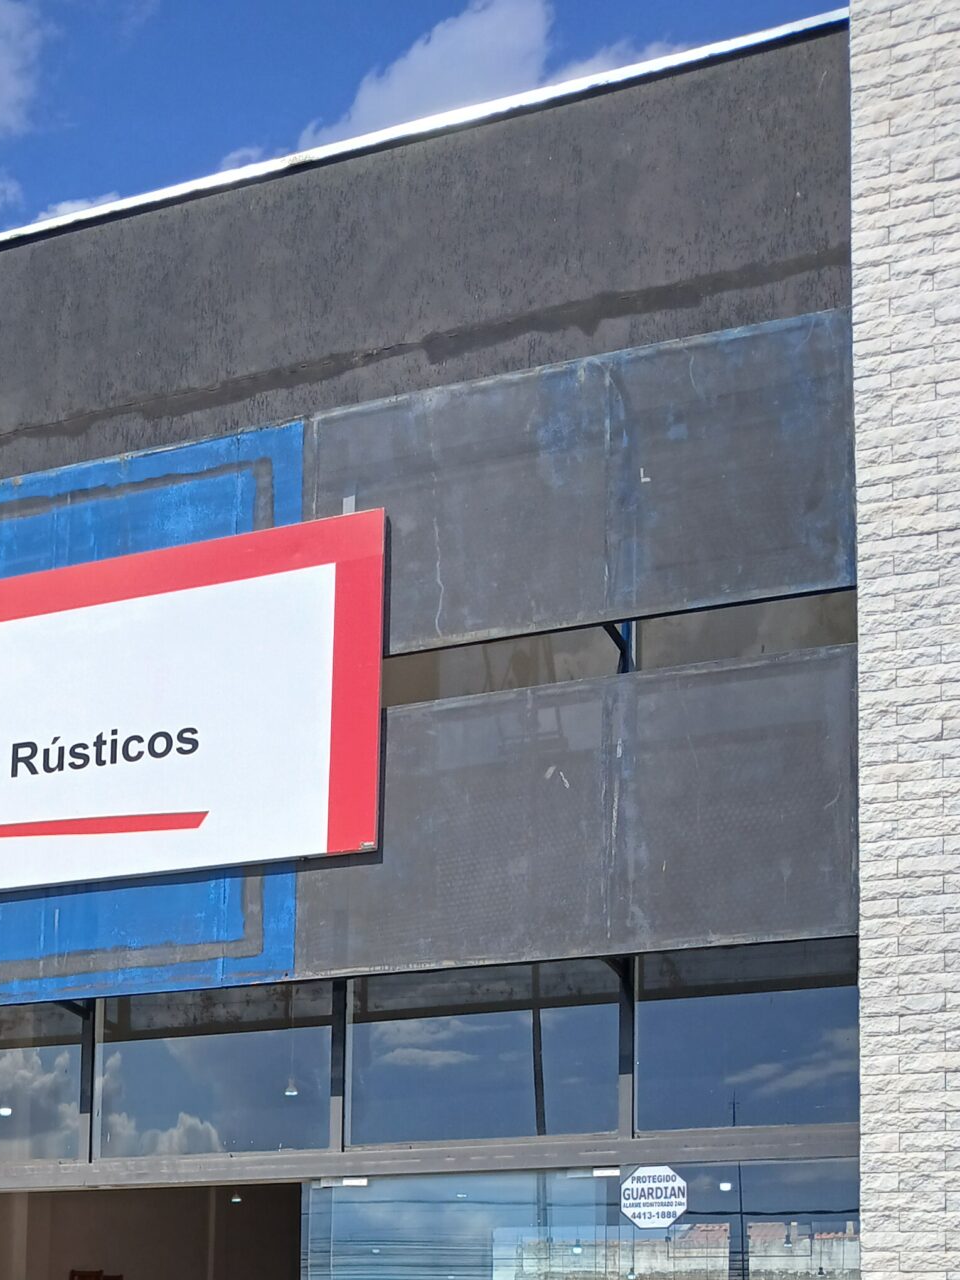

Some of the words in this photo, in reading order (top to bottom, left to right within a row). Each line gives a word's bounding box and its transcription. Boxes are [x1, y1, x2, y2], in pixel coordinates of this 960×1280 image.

[10, 725, 200, 779] Rústicos
[631, 1175, 677, 1184] PROTEGIDO
[622, 1185, 686, 1200] GUARDIAN
[631, 1211, 677, 1220] 4413-1888
